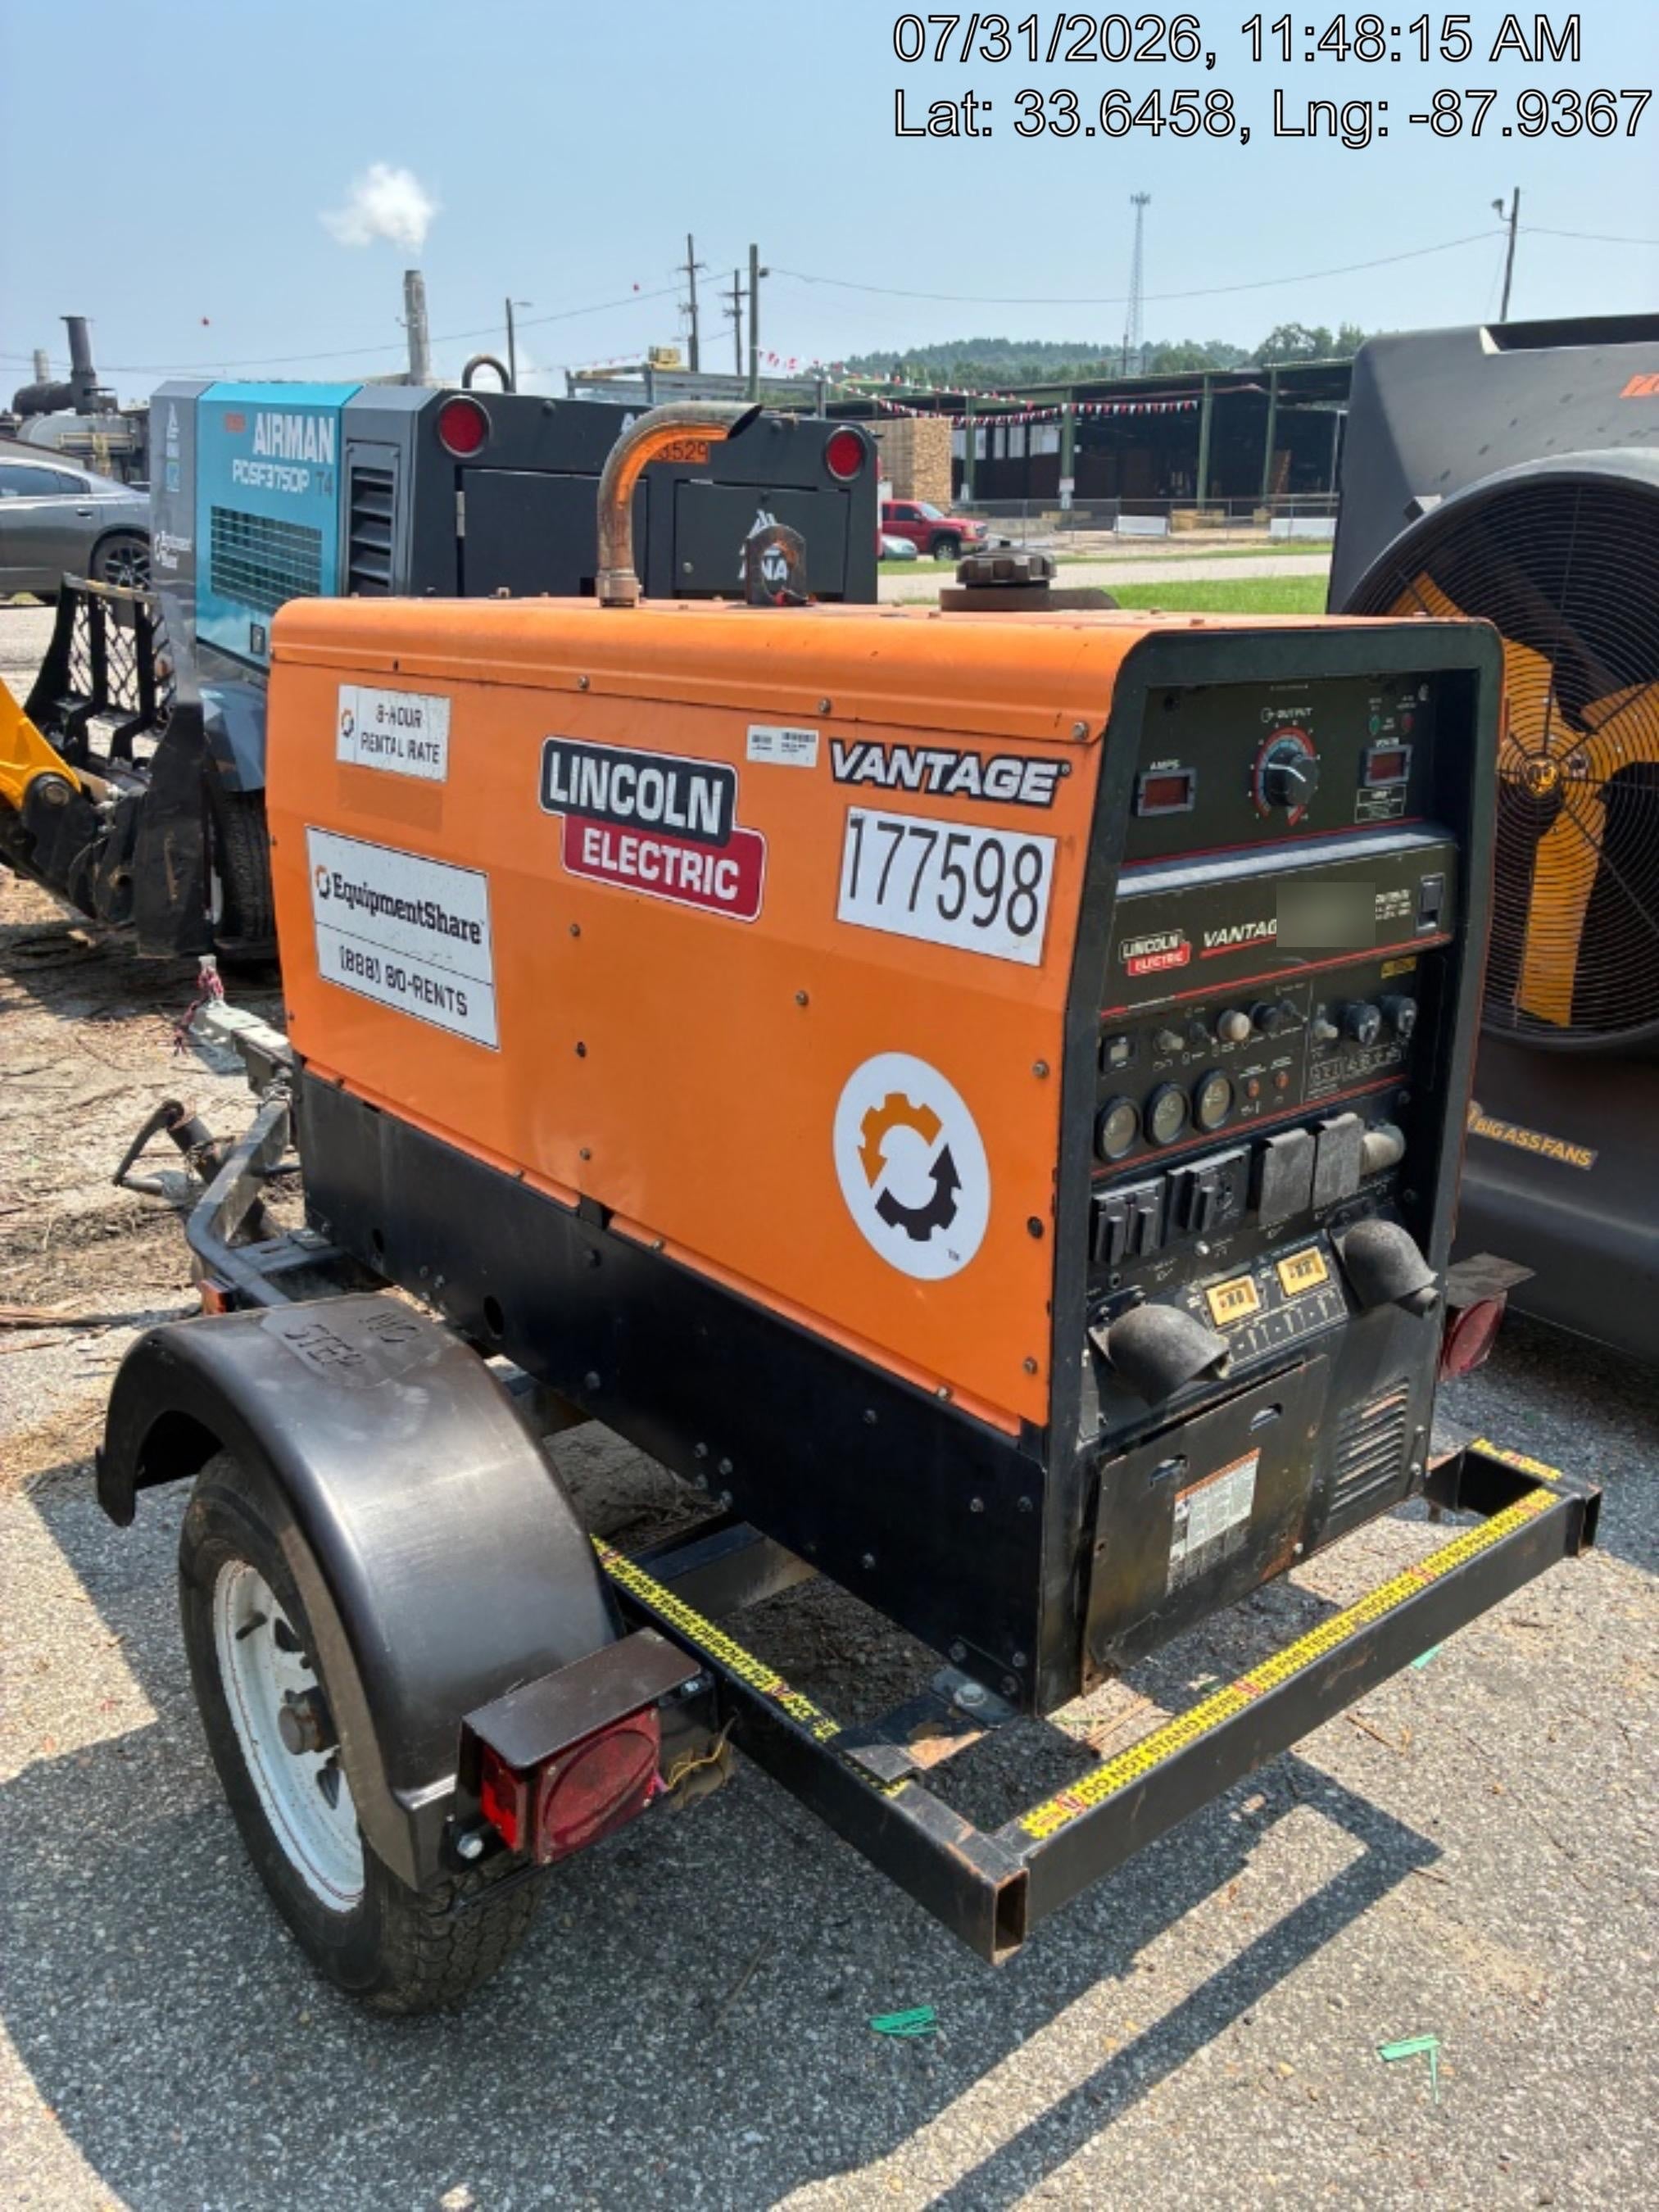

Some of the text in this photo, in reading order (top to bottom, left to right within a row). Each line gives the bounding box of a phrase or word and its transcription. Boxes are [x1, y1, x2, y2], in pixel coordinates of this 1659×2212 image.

[253, 413, 334, 465] AIRMAN
[376, 703, 423, 728] 8-HOUR
[361, 732, 440, 764] RENTAL RATE
[549, 751, 724, 836] LINCOLN
[582, 827, 740, 900] ELECTRIC
[850, 818, 1044, 937] 177598
[332, 872, 482, 945] EquipmentShare
[1123, 934, 1178, 959] LINCOLN
[1135, 950, 1184, 971] ELECTRIC
[339, 945, 469, 1017] (888) 80-RENTS
[1540, 1138, 1592, 1167] FANS
[1081, 1778, 1110, 1797] DO
[1108, 1754, 1143, 1779] NOT
[1145, 1719, 1200, 1755] STAND
